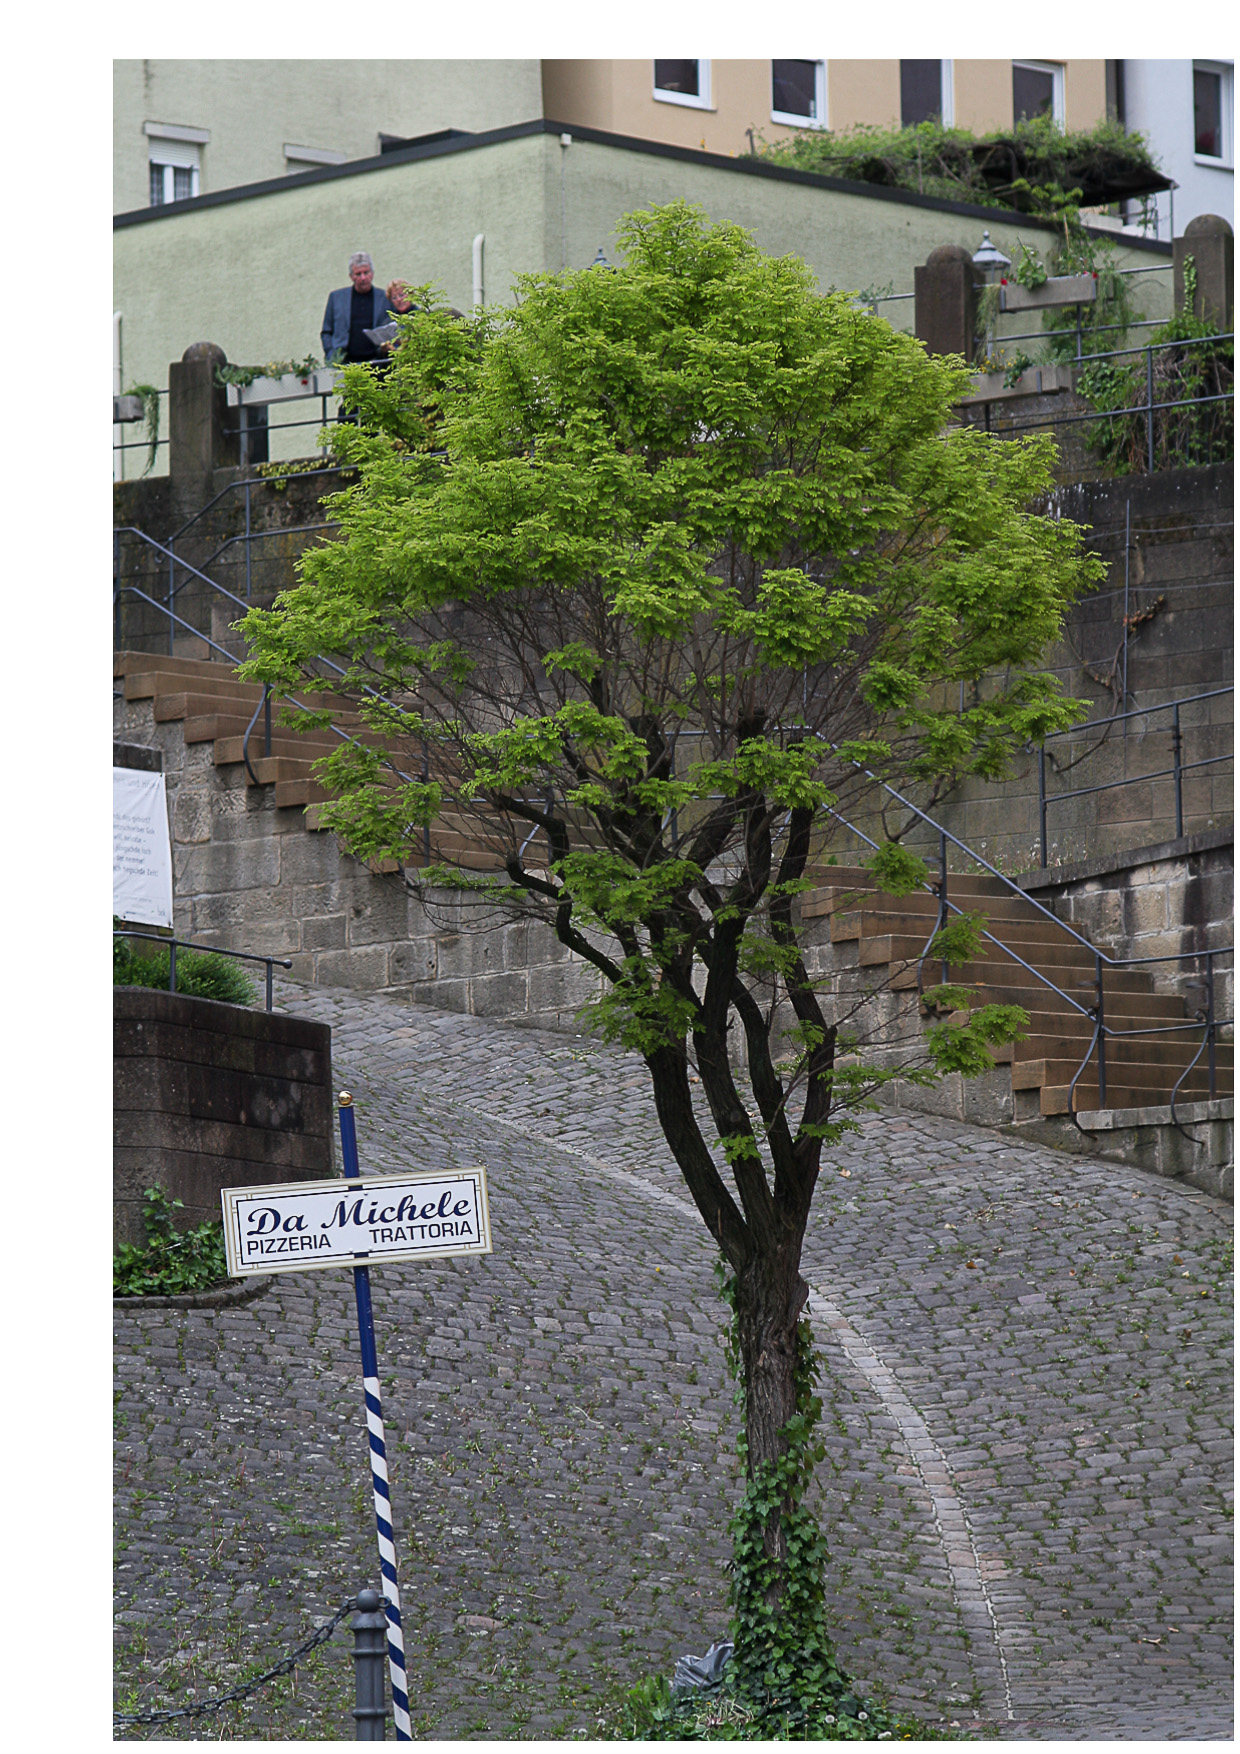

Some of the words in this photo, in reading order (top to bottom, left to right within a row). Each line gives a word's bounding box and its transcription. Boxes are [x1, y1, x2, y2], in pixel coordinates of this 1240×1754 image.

[246, 1207, 308, 1236] Da
[321, 1191, 472, 1229] Michele
[247, 1233, 331, 1255] PIZZERIA
[369, 1220, 473, 1243] TRATTORIA
